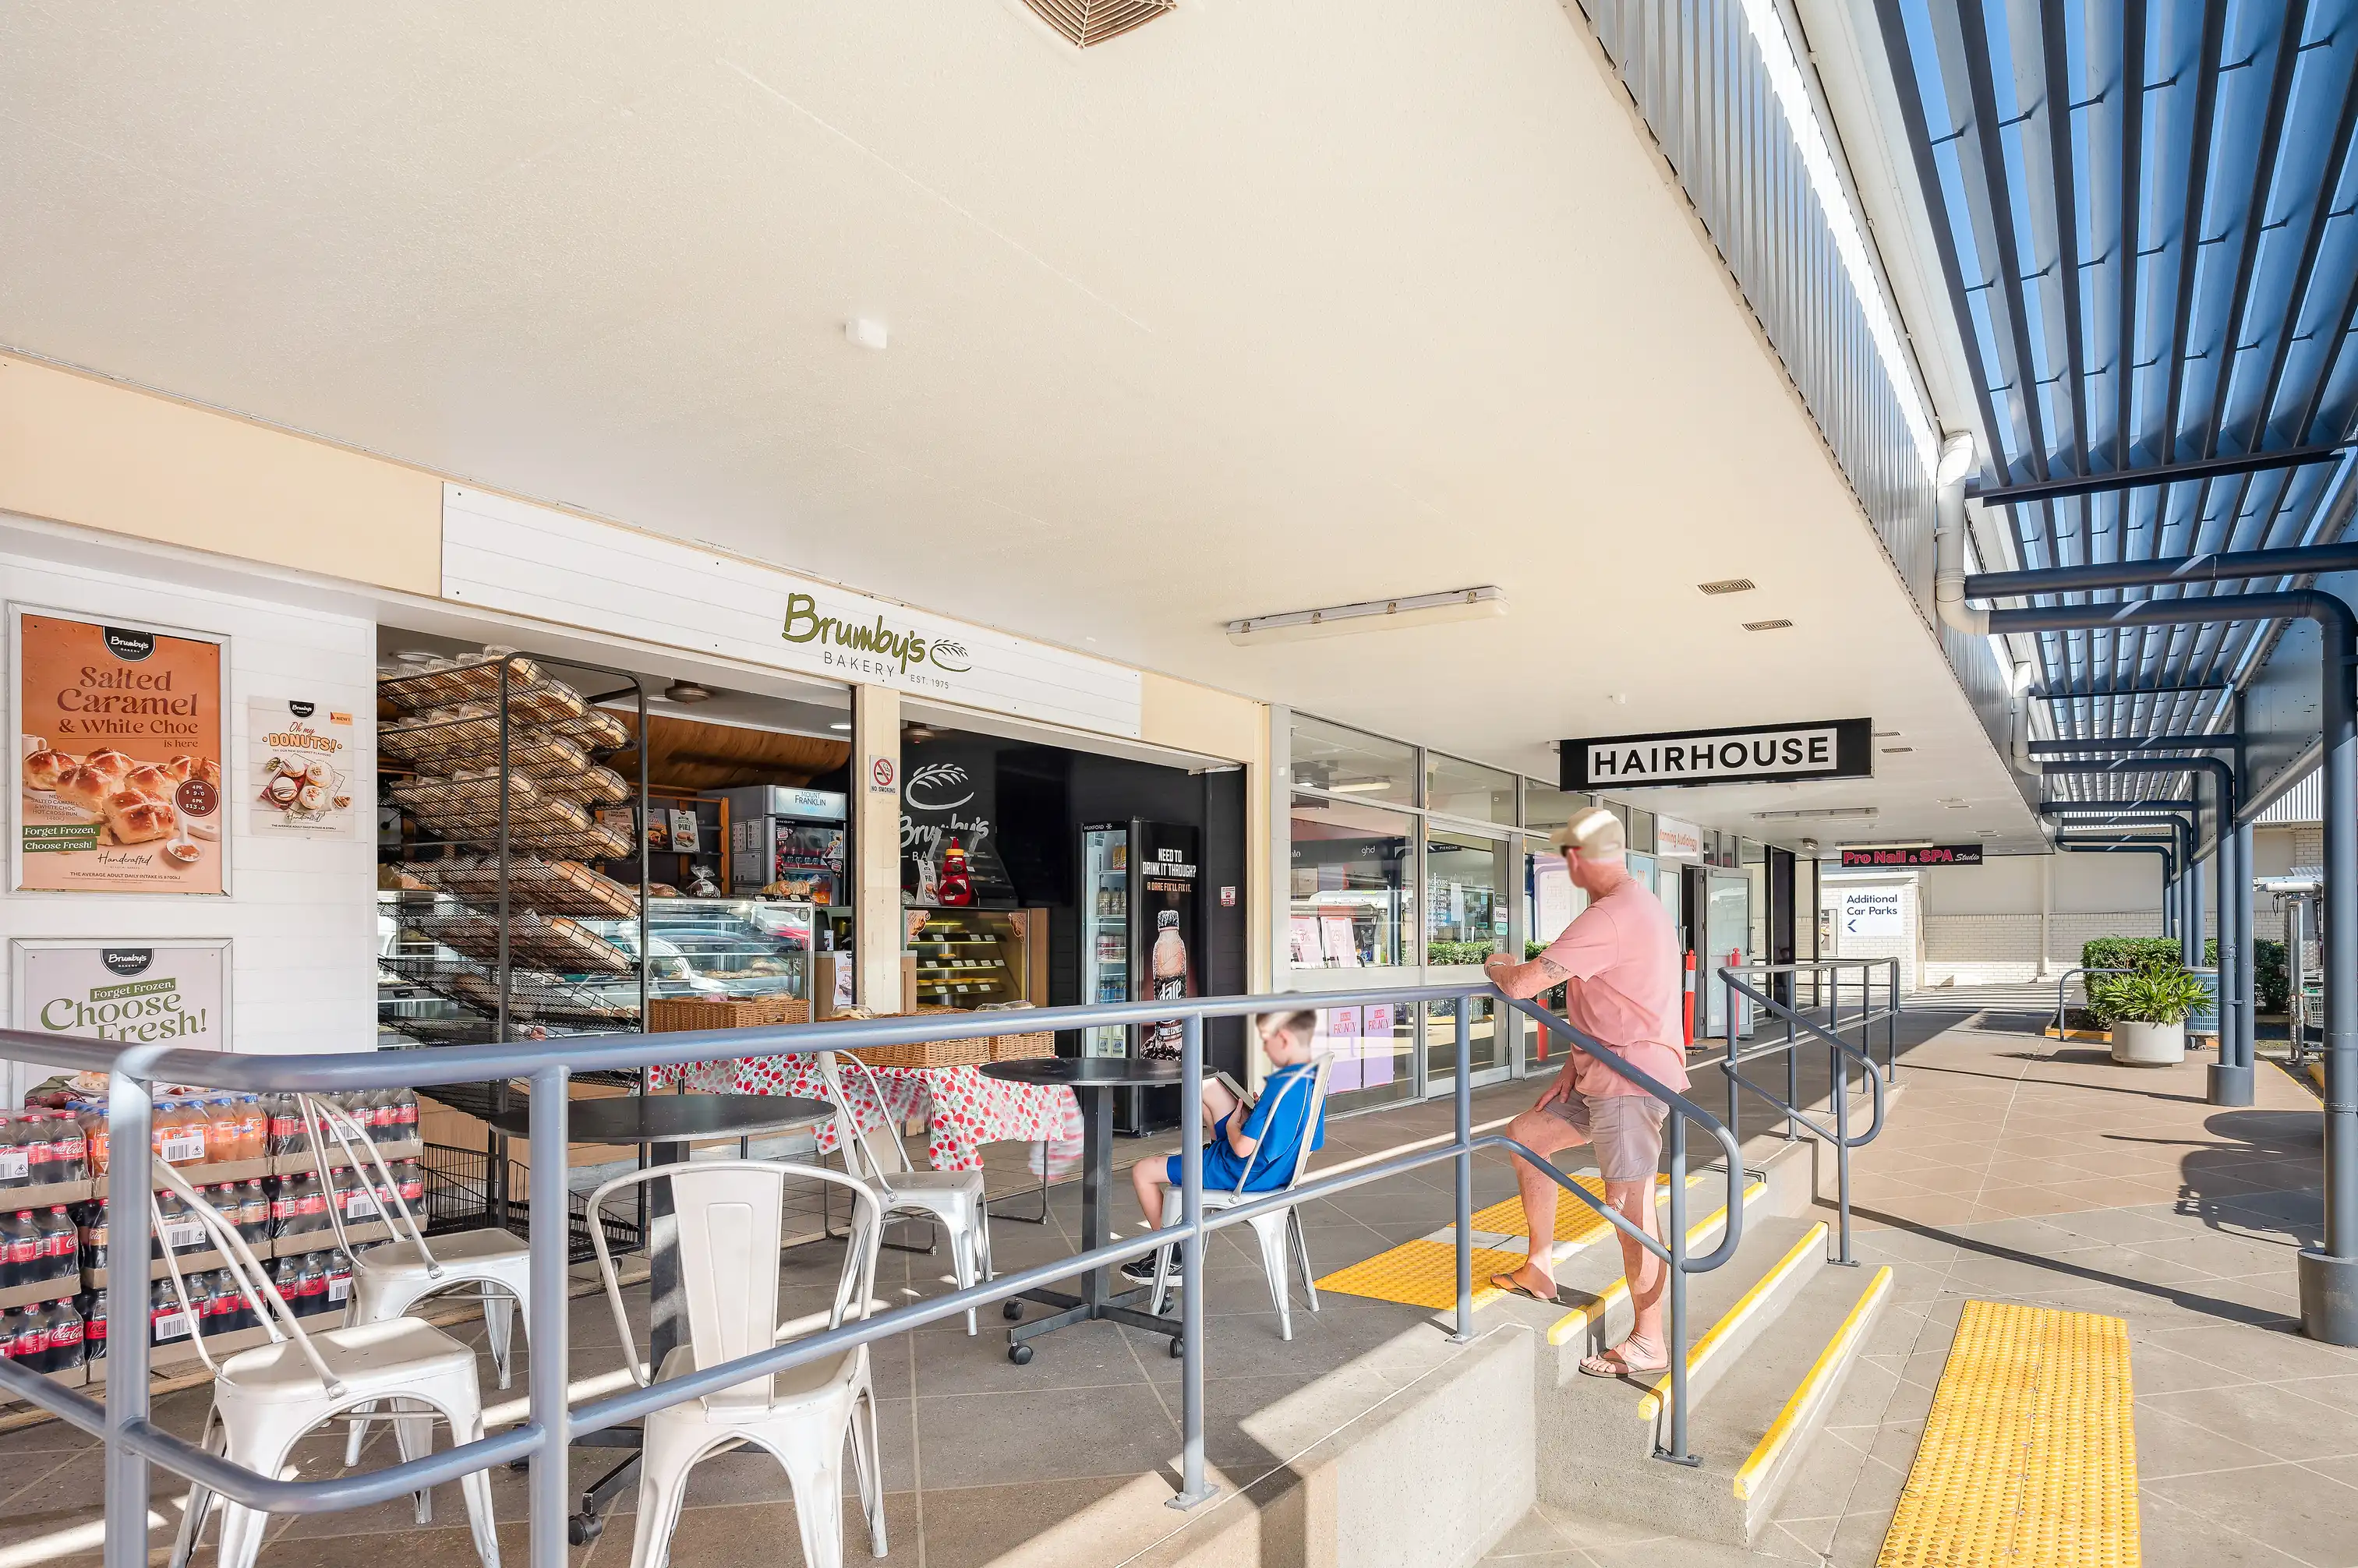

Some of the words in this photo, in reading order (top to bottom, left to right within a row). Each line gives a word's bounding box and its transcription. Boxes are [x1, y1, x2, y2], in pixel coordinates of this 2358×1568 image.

[781, 592, 926, 675] Brumby's
[110, 635, 149, 651] Brumby's
[823, 652, 896, 678] BAKERY
[80, 666, 171, 691] Salted
[910, 674, 928, 686] EST.
[931, 678, 949, 690] 1975
[57, 688, 198, 716] Caramel
[58, 718, 76, 734] &
[80, 718, 144, 734] White
[150, 719, 199, 735] Choc
[289, 722, 303, 733] Oh
[164, 740, 172, 748] is
[175, 740, 199, 748] here
[268, 733, 338, 754] DONUTS!
[1594, 736, 1830, 776] HAIRHOUSE
[795, 795, 826, 807] FRANKLIN
[24, 827, 58, 837] Forget
[63, 841, 93, 849] Fresh!
[1361, 846, 1376, 856] ghd
[1677, 833, 1699, 853] Audiology
[97, 851, 153, 866] Handcrafted
[1158, 848, 1174, 862] NEED
[1174, 849, 1182, 863] TO
[1844, 852, 1872, 864] Pro
[1874, 850, 1906, 863] Nail
[1919, 849, 1954, 863] SPA
[1955, 852, 1980, 862] Studio
[1143, 861, 1160, 875] DRINK
[1161, 863, 1167, 876] IT
[1168, 863, 1197, 878] THROUGH?
[1151, 882, 1163, 891] DARE
[1847, 894, 1897, 904] Additional
[1847, 906, 1865, 916] Car
[1868, 906, 1898, 916] Parks
[108, 952, 147, 964] Brumby's
[94, 987, 130, 999] Forget
[133, 981, 175, 994] Frozen,
[1158, 979, 1182, 1001] dare
[41, 994, 182, 1031] Choose
[97, 1008, 207, 1043] Fresh!
[51, 1326, 83, 1342] Coca-Col
